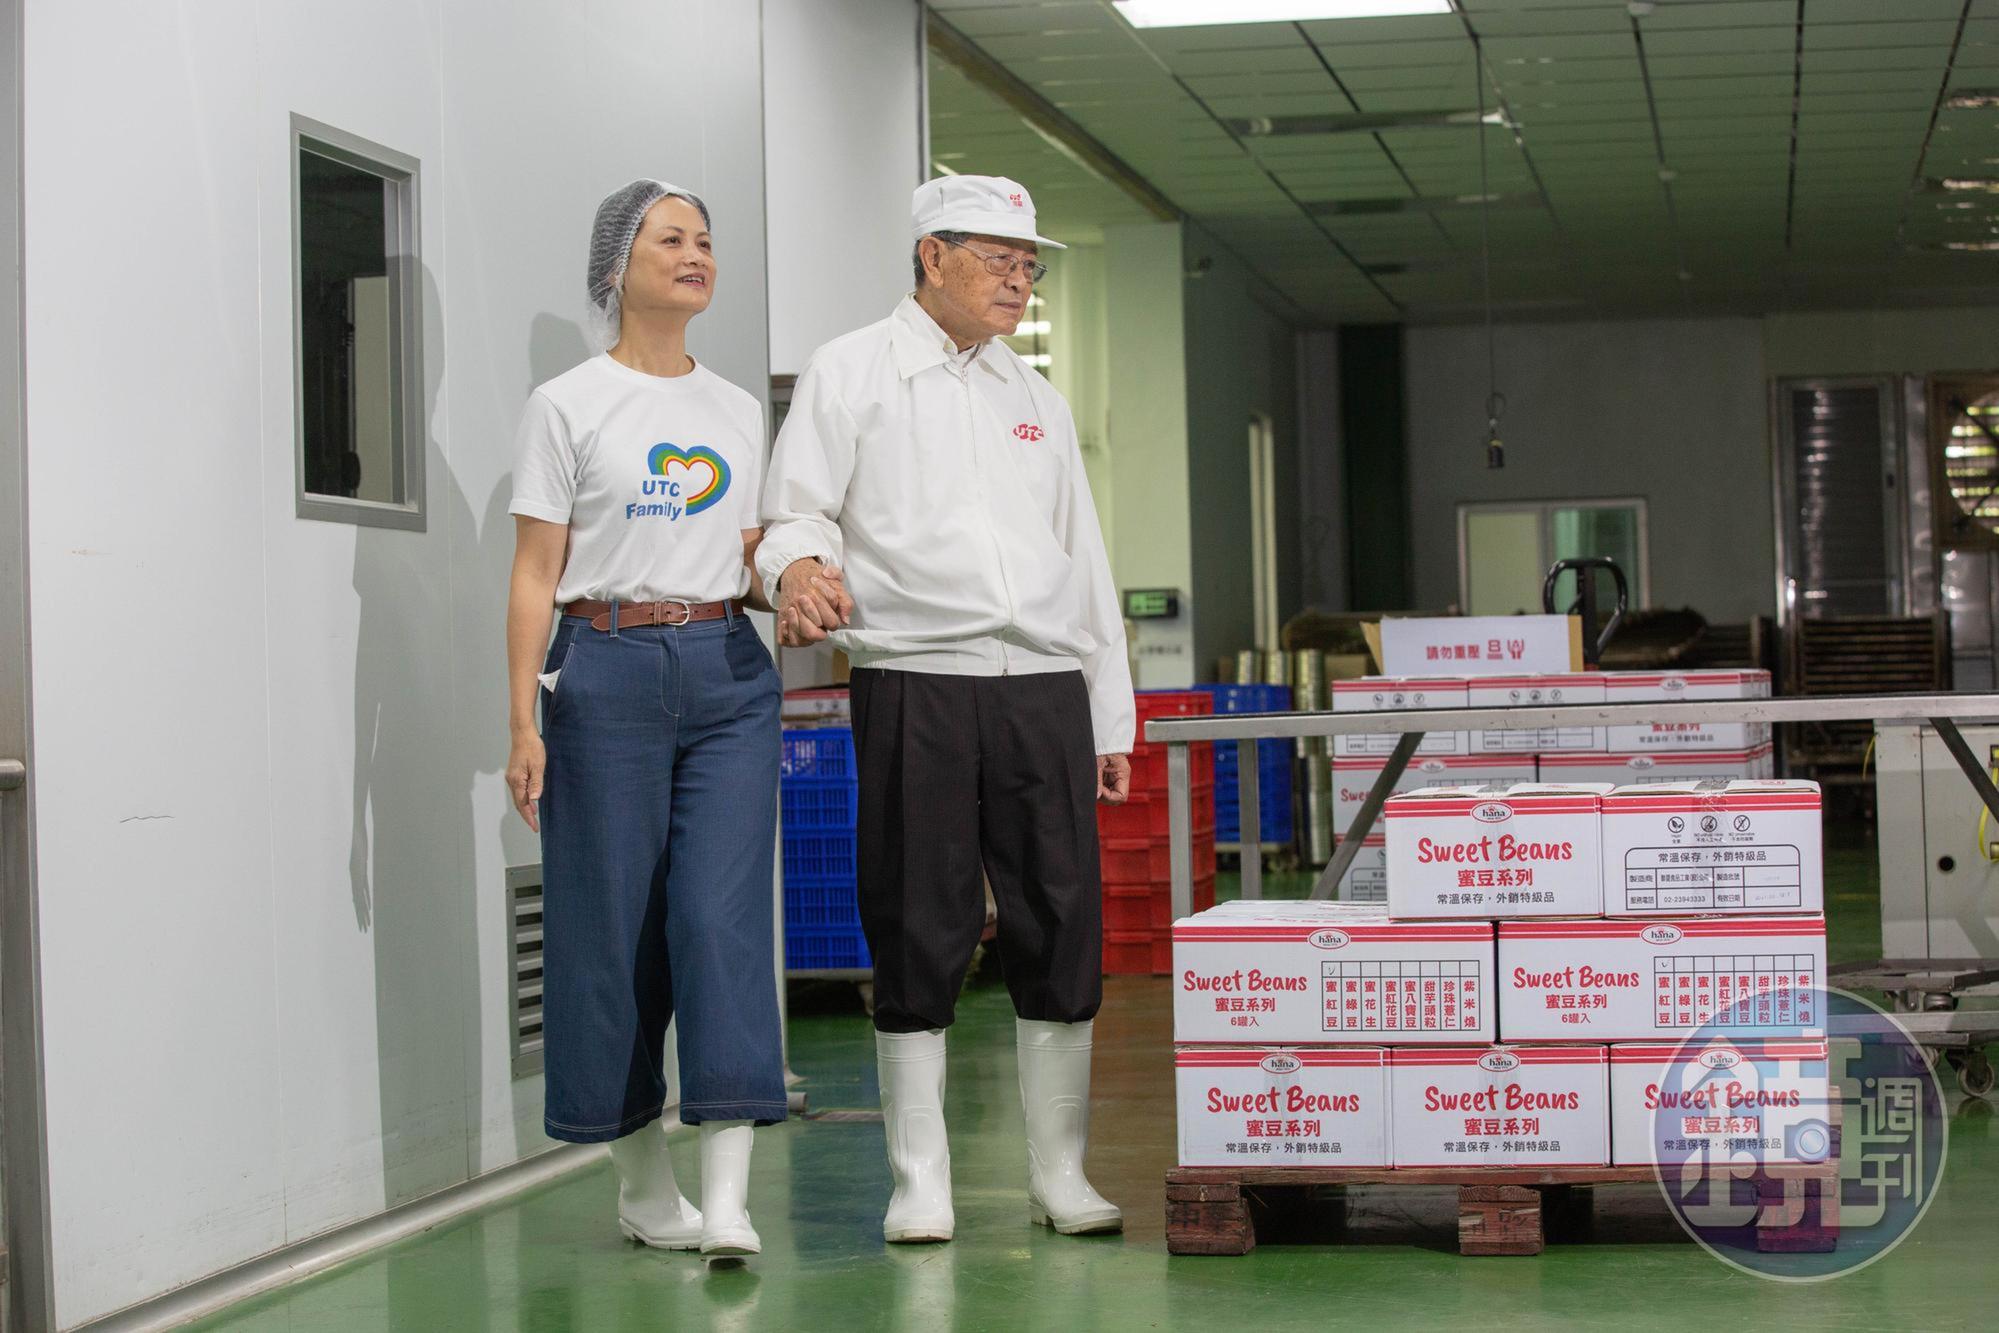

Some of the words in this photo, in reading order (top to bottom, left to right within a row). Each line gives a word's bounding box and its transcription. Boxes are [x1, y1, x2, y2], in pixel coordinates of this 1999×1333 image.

[642, 480, 680, 497] UTC
[626, 502, 682, 521] Family
[1426, 645, 1480, 661] 請勿重壓
[1418, 836, 1492, 864] Sweet
[1498, 833, 1572, 862] Beans
[1457, 868, 1533, 887] 蜜豆系列
[1184, 970, 1243, 992] Sweet
[1247, 969, 1307, 992] Beans
[1513, 967, 1573, 989] Sweet
[1578, 965, 1639, 988] Beans
[1216, 997, 1276, 1012] 蜜豆系列
[1324, 980, 1338, 1028] 蜜紅豆
[1344, 980, 1358, 1028] 蜜綠豆
[1364, 980, 1378, 1028] 蜜花生
[1384, 980, 1398, 1028] 蜜紅花豆
[1423, 980, 1438, 1028] 甜芋頭粒
[1546, 994, 1607, 1009] 蜜豆系列
[1658, 976, 1670, 1024] 蜜紅豆
[1678, 976, 1691, 1024] 蜜綠豆
[1697, 976, 1710, 1024] 蜜花生
[1718, 975, 1731, 1024] 蜜紅花豆
[1206, 1087, 1280, 1115] Sweet
[1286, 1084, 1360, 1114] Beans
[1424, 1084, 1500, 1114] Sweet
[1503, 1082, 1580, 1113] Beans
[1643, 1082, 1720, 1111] Sweet
[1725, 1080, 1799, 1108] Beans
[1246, 1118, 1321, 1138] 蜜豆系列
[1464, 1116, 1540, 1137] 蜜豆系列
[1684, 1116, 1760, 1134] 蜜豆系列
